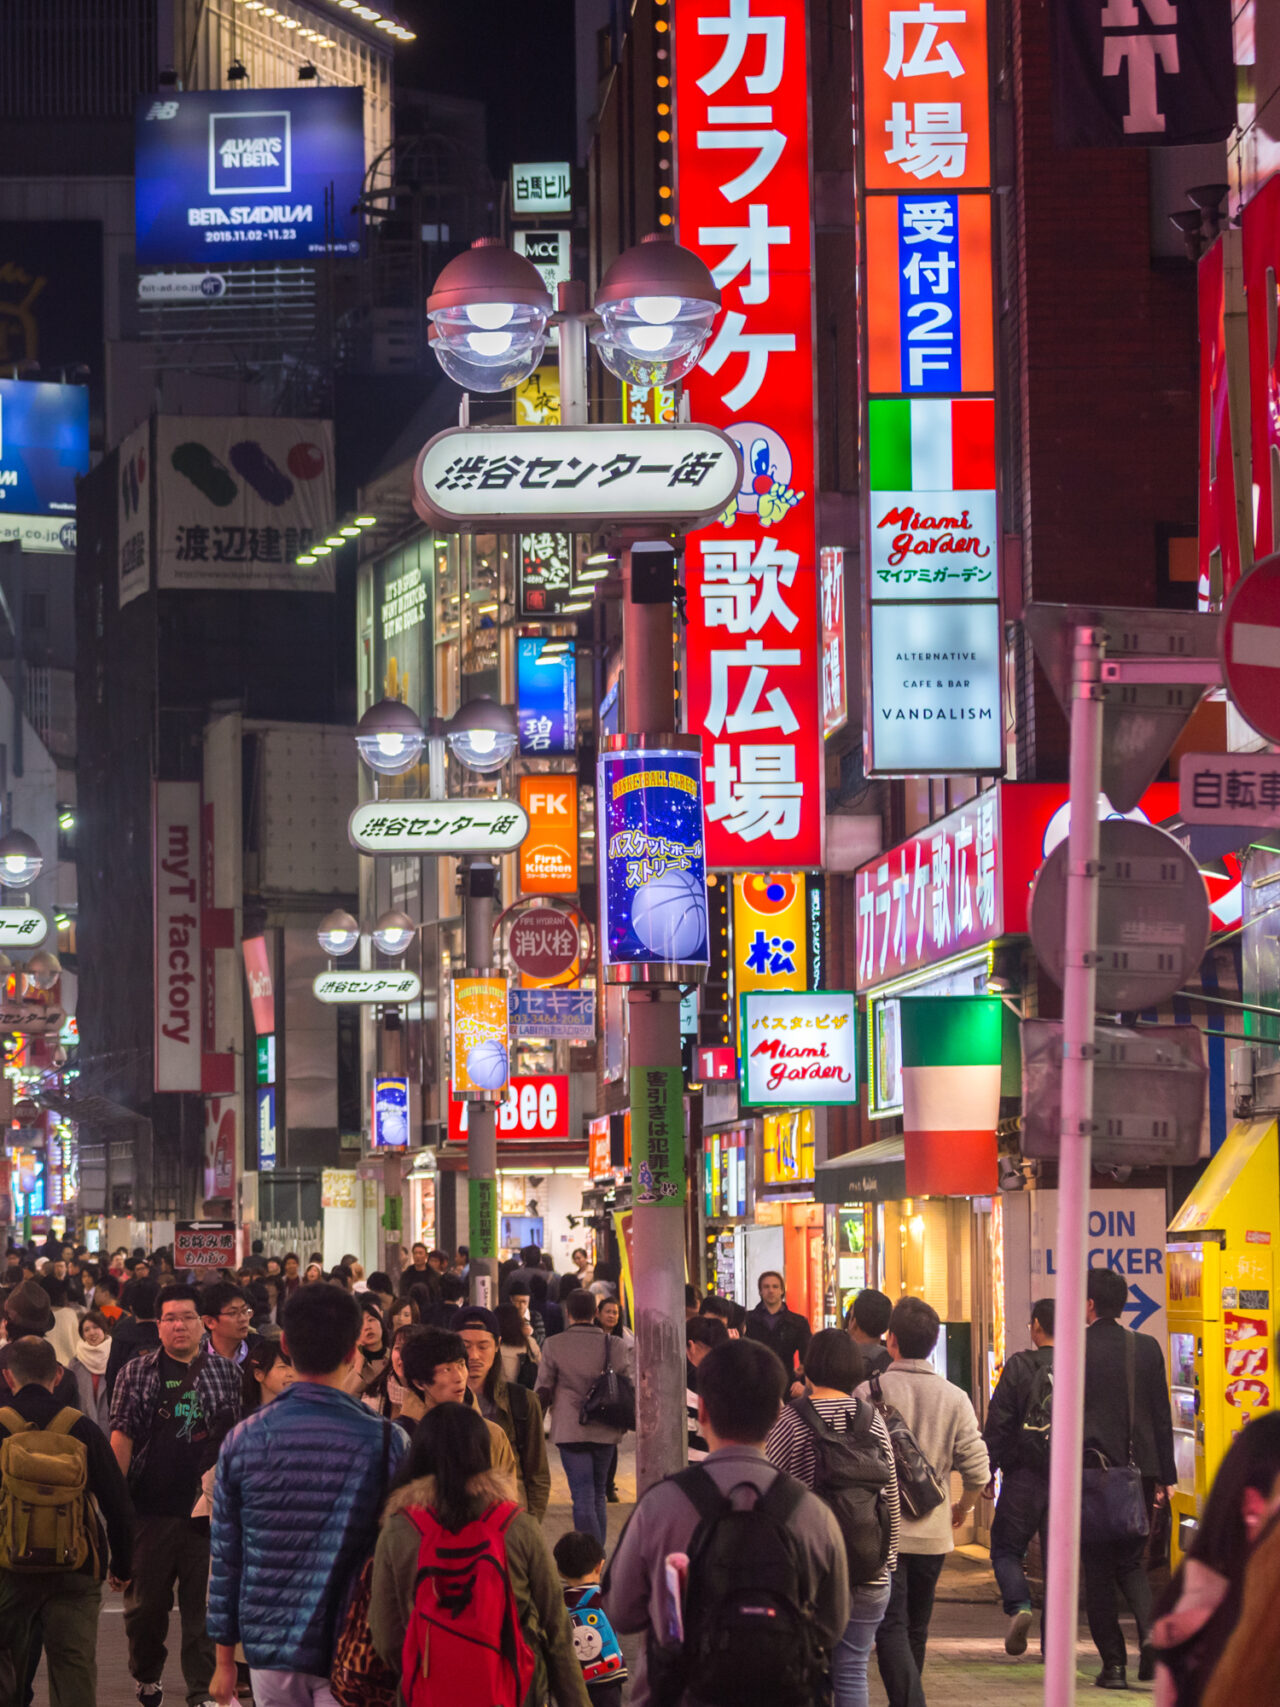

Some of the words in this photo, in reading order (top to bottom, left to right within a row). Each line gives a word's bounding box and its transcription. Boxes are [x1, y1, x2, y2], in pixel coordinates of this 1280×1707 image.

[884, 5, 967, 179] 広場
[219, 137, 282, 154] ALWAYS
[223, 154, 242, 168] IN
[243, 152, 280, 168] BETA
[517, 176, 570, 200] 白馬ビル
[189, 206, 230, 227] BETA
[230, 205, 313, 225] STADIUM
[696, 0, 796, 412] カラオケ
[526, 244, 559, 257] MCC
[903, 201, 955, 386] 受付2F
[435, 452, 723, 491] 渋谷センター街
[877, 507, 973, 531] Miami
[877, 568, 992, 583] マイアミガーデン
[896, 653, 977, 662] ALTERNATIVE
[700, 536, 803, 843] 歌広場
[903, 680, 934, 688] CAFE
[948, 680, 971, 688] BAR
[882, 707, 992, 721] VANDALISM
[524, 716, 553, 751] 碧
[612, 771, 668, 801] BASKETBALL
[530, 794, 568, 814] FK
[361, 816, 518, 836] 渋谷センター街
[526, 863, 571, 873] Kitchen
[535, 855, 562, 864] First
[627, 858, 690, 885] ストリート
[858, 816, 995, 984] カラオケ歌広場
[520, 917, 535, 925] FIRE
[536, 917, 567, 925] HYDRANT
[516, 930, 574, 956] 消火栓
[745, 931, 796, 975] 松
[162, 914, 197, 1045] factory
[320, 979, 415, 994] 渋谷センター街
[521, 990, 593, 1014] セキネ
[752, 1013, 850, 1031] パスタとピザ
[750, 1038, 830, 1060] Miami
[701, 1051, 728, 1078] 1F
[1086, 1210, 1135, 1237] OIN
[1047, 1247, 1164, 1275] LCKER
